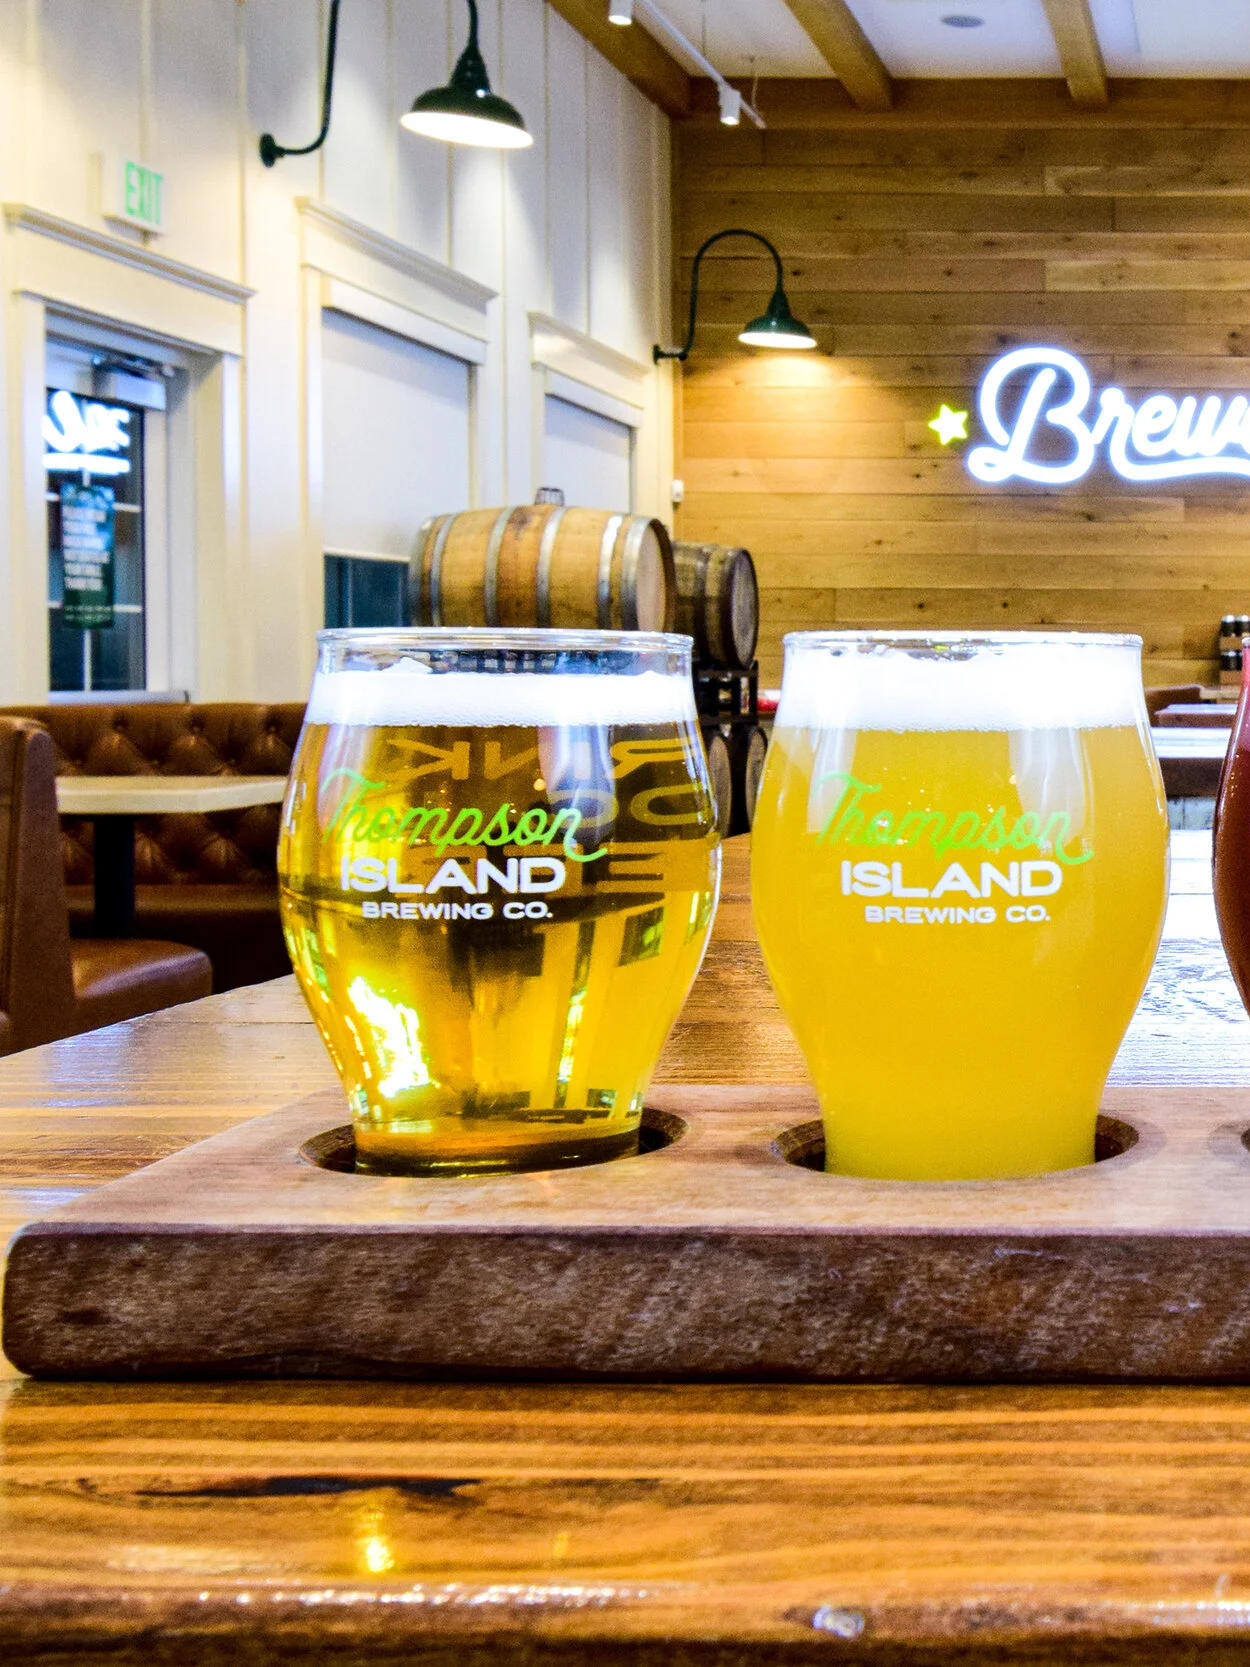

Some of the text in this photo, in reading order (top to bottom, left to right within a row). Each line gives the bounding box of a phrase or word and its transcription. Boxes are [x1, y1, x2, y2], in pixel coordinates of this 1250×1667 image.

[124, 160, 163, 225] EXIT
[320, 767, 608, 862] Thompson
[812, 771, 1095, 865] Thompson
[341, 856, 566, 894] ISLAND
[841, 860, 1063, 898] ISLAND
[361, 901, 554, 920] BREWING CO.
[865, 904, 1051, 924] BREWING CO.
